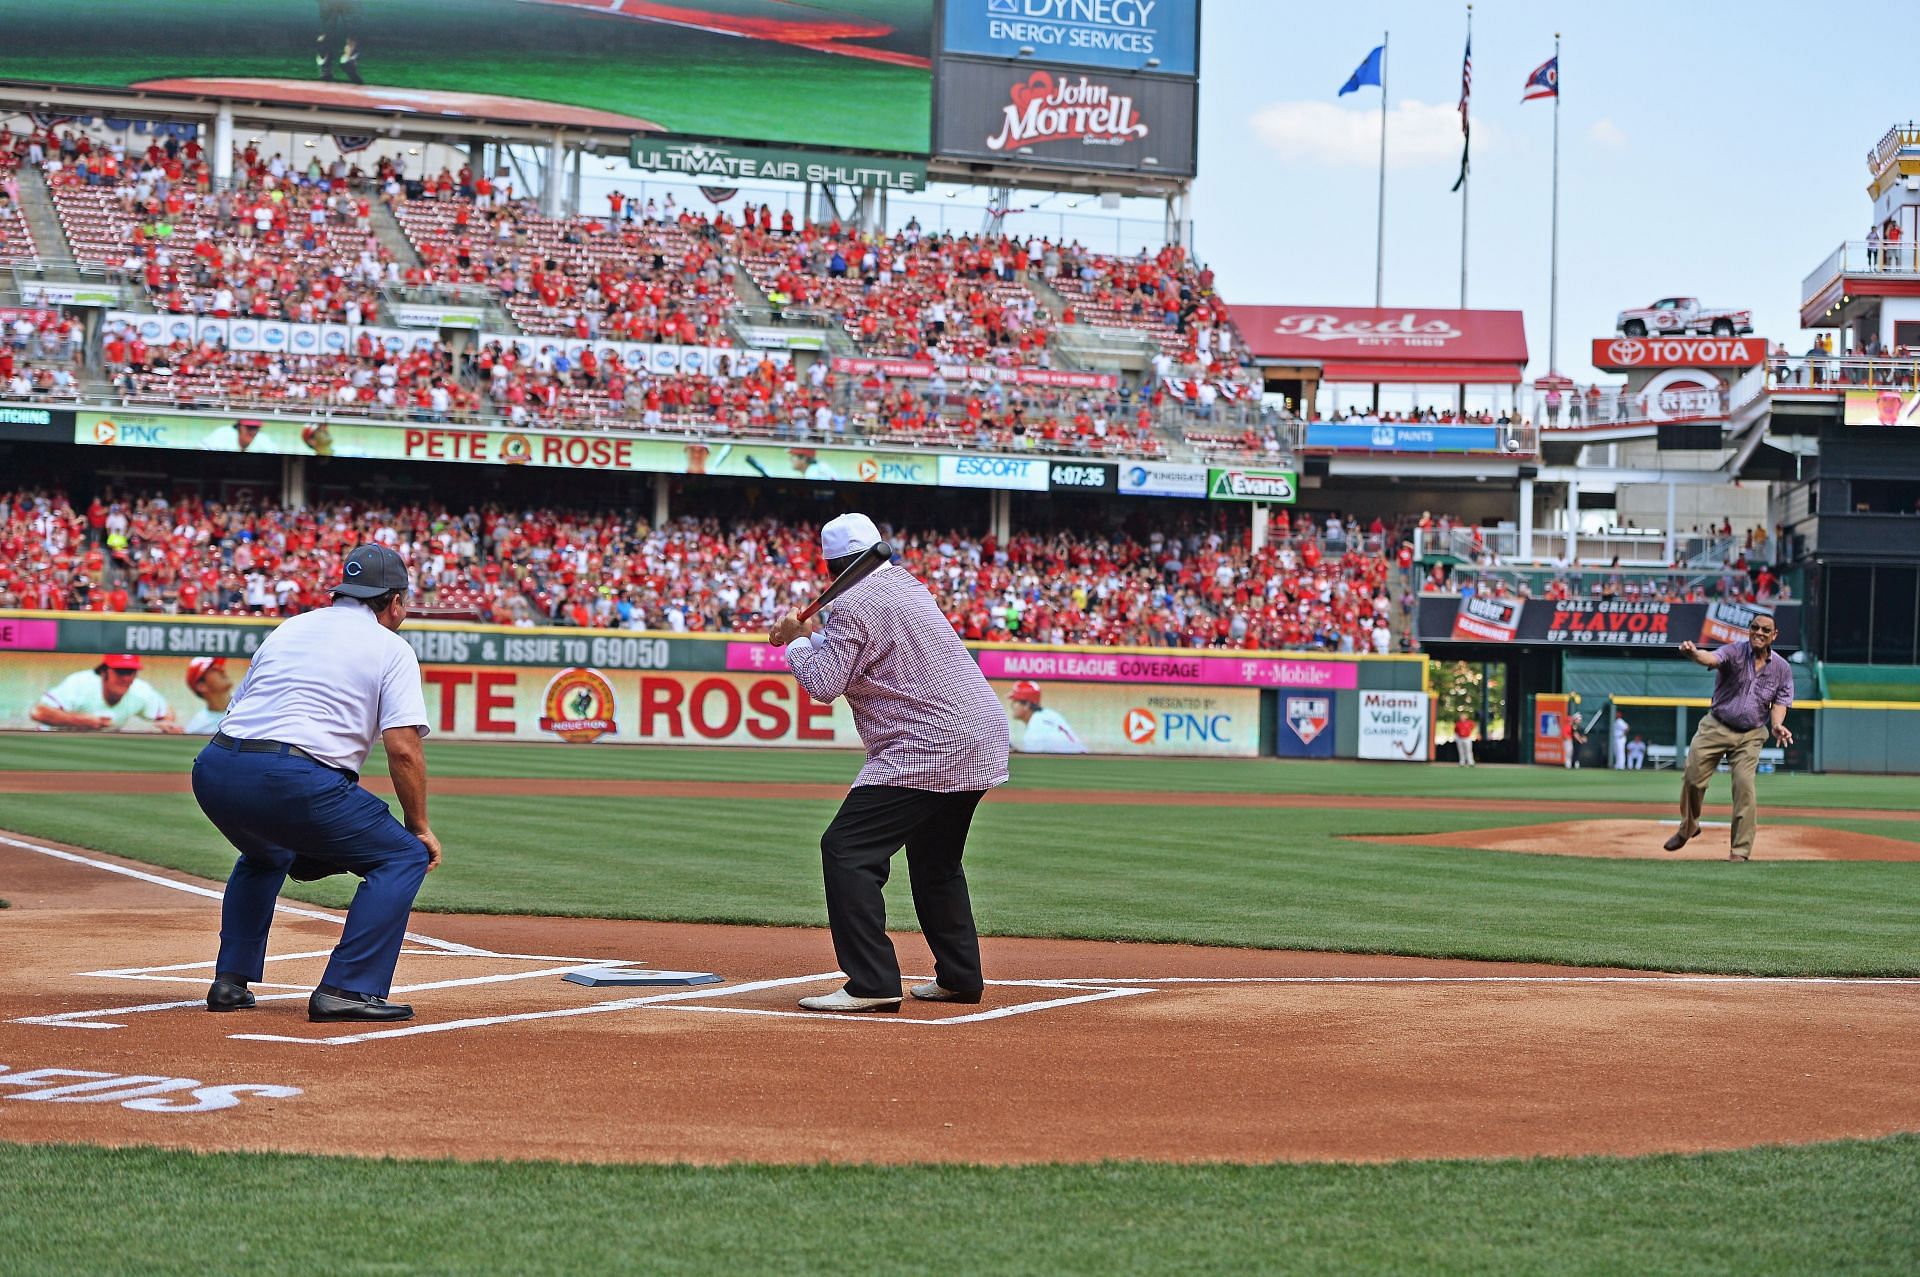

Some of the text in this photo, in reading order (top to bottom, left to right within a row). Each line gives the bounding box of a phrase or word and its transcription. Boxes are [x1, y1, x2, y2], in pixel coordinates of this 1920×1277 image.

[1023, 0, 1157, 27] DYNEGY
[989, 21, 1155, 54] ENERGY SERVICES
[1046, 77, 1109, 105] John
[986, 97, 1149, 150] Morrell
[636, 151, 915, 189] ULTIMATE AIR SHUTTLE
[1274, 314, 1463, 341] Reds
[1648, 341, 1750, 362] TOYOTA
[0, 407, 50, 425] ITCHING
[120, 425, 168, 444] PNC
[1398, 430, 1434, 442] PAINTS
[405, 429, 632, 467] PETE ROSE
[881, 463, 924, 481] PNC
[956, 458, 1031, 478] ESCORT
[1051, 465, 1105, 486] 4:07:35
[1231, 472, 1290, 494] Evans
[1555, 601, 1670, 613] CALL GRILLING
[1550, 611, 1669, 632] FLAVOR
[126, 626, 164, 650] FOR
[168, 627, 240, 651] SAFETY
[243, 632, 258, 653] &
[1548, 630, 1567, 642] UP
[1571, 631, 1592, 643] TO
[1596, 631, 1626, 643] THE
[482, 641, 497, 661] &
[503, 638, 560, 662] ISSUE
[563, 641, 586, 663] TO
[591, 638, 669, 668] 69050
[1004, 656, 1200, 678] MAJOR LEAGUE COVERAGE
[424, 671, 517, 733] TE
[640, 677, 835, 740] ROSE
[1148, 697, 1201, 709] PRESENTED
[1365, 695, 1418, 708] Miami
[1164, 713, 1232, 742] PNC
[1371, 711, 1421, 728] Valley
[1363, 728, 1408, 737] GAMING
